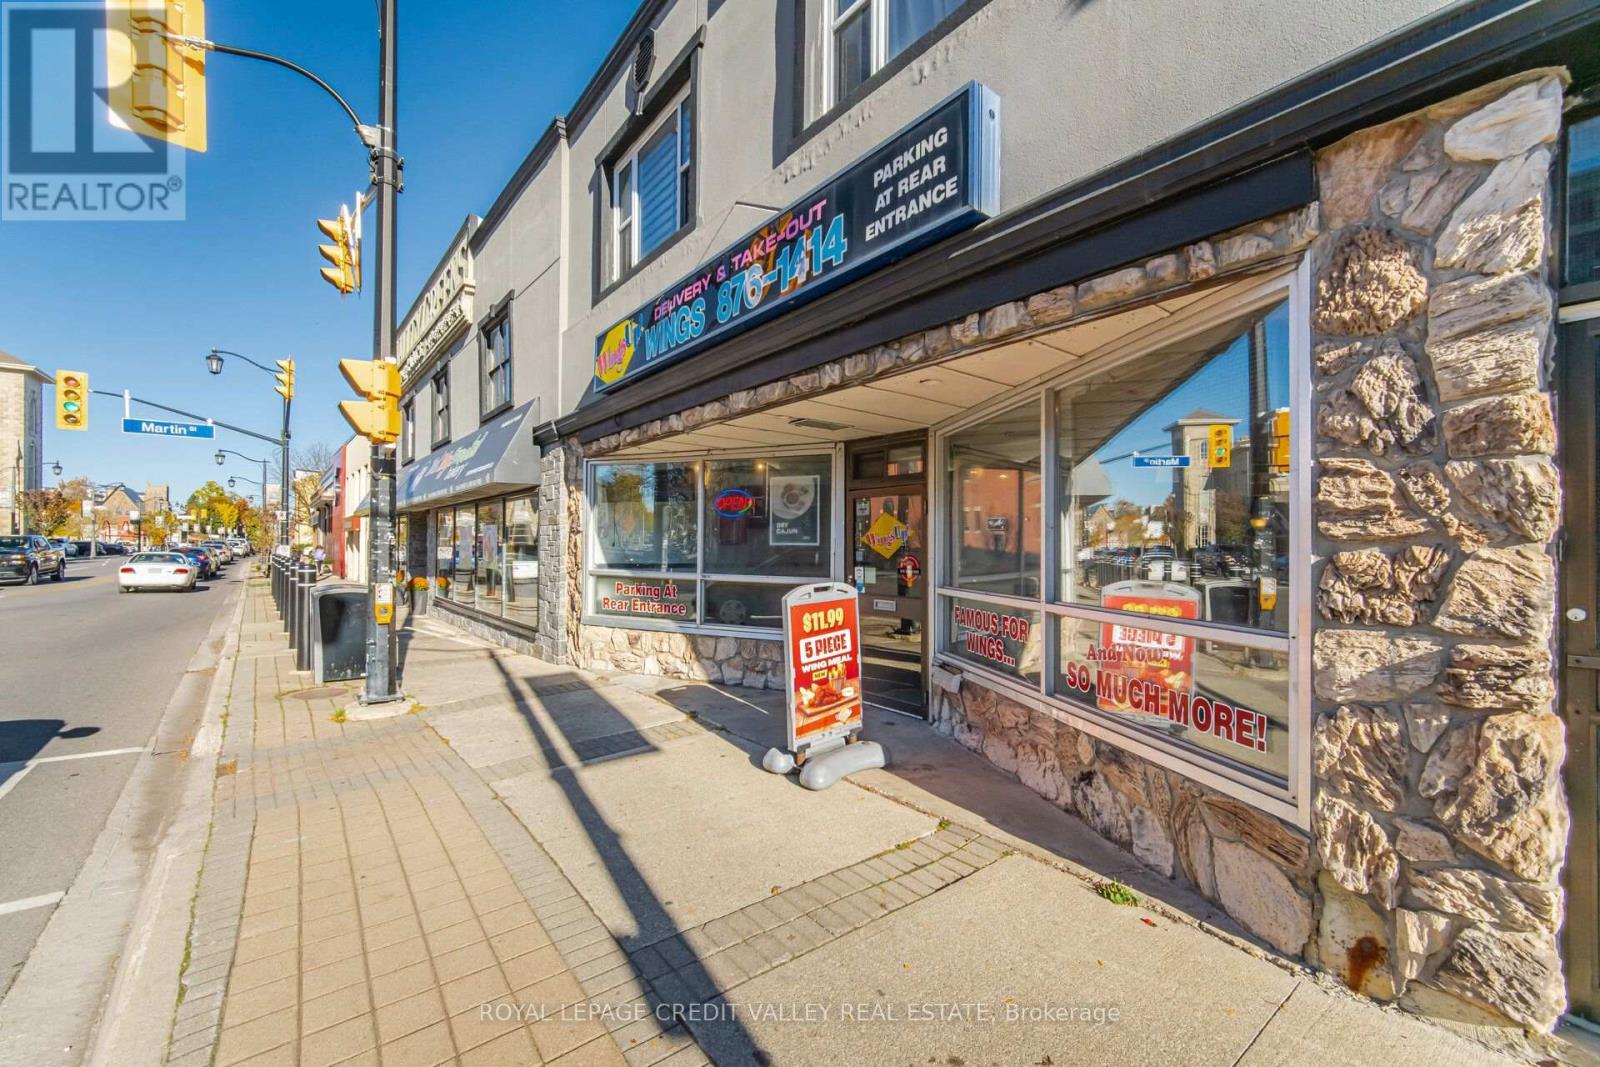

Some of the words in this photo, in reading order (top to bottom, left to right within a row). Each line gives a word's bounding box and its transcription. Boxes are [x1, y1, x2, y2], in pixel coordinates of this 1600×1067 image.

[873, 127, 948, 188] PARKING
[875, 186, 894, 213] AT
[898, 155, 947, 198] REAR
[865, 176, 958, 241] ENTRANCE
[654, 274, 711, 321] DELIVERY
[716, 265, 726, 283] &
[731, 199, 827, 271] TAKE-OUT
[644, 297, 706, 361] WINGS
[717, 213, 848, 323] 876-1414
[141, 422, 187, 435] Martin
[716, 495, 750, 511] OPEN
[602, 597, 629, 611] Rear
[631, 598, 686, 615] Entrance
[615, 581, 661, 600] Parking
[663, 584, 677, 598] At
[803, 607, 844, 633] $11.99
[954, 605, 999, 635] FAMOUS
[1001, 614, 1030, 642] FOR
[805, 641, 813, 658] 5
[815, 633, 847, 656] PIECE
[966, 631, 1016, 667] WINGS...
[1087, 644, 1117, 662] And
[802, 661, 827, 673] WING
[828, 654, 852, 667] MEAL
[1066, 661, 1092, 693] SO
[1096, 670, 1161, 716] MUCH
[1168, 688, 1267, 754] MORE!
